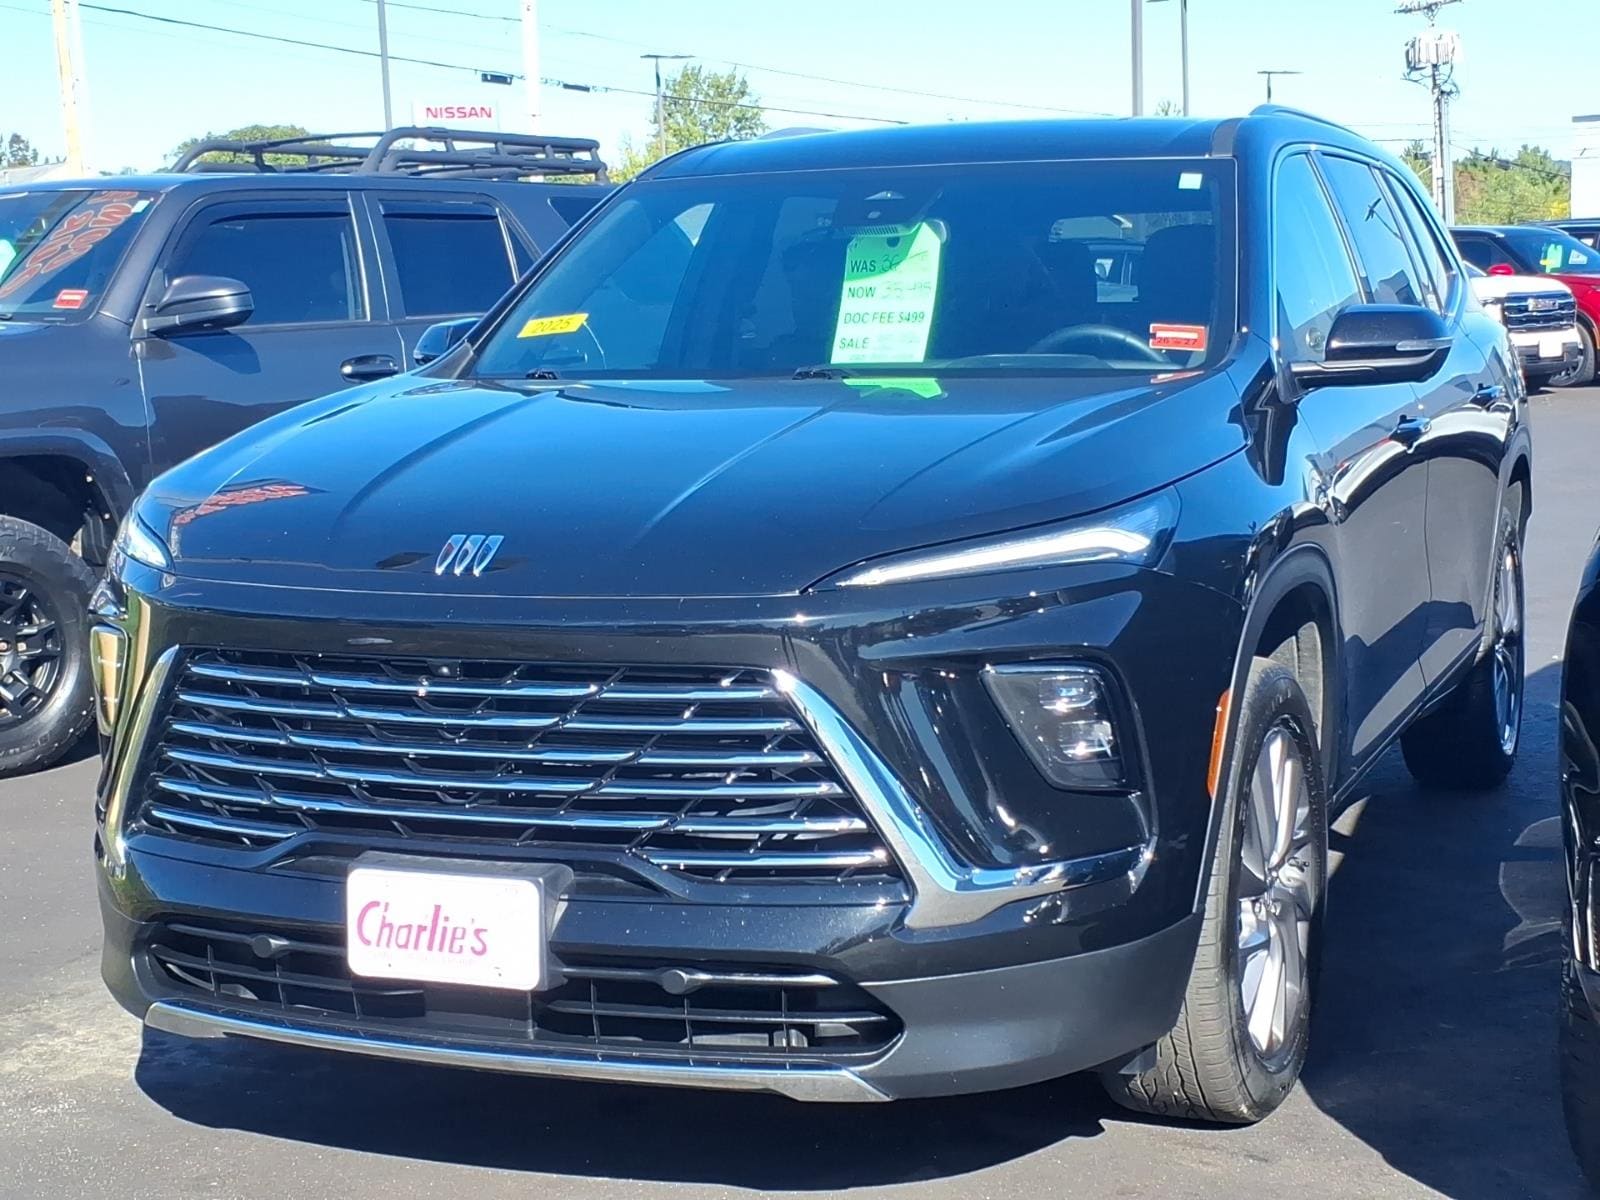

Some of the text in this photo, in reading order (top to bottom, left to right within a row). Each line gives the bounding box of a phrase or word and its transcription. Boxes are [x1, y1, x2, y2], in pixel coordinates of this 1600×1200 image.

[426, 106, 492, 119] NISSAN
[850, 259, 877, 273] WAS
[847, 286, 876, 299] NOW
[843, 311, 925, 324] DOC FEE $499
[531, 318, 574, 334] 2025
[839, 337, 870, 349] SALE
[356, 900, 488, 956] Charlie's
